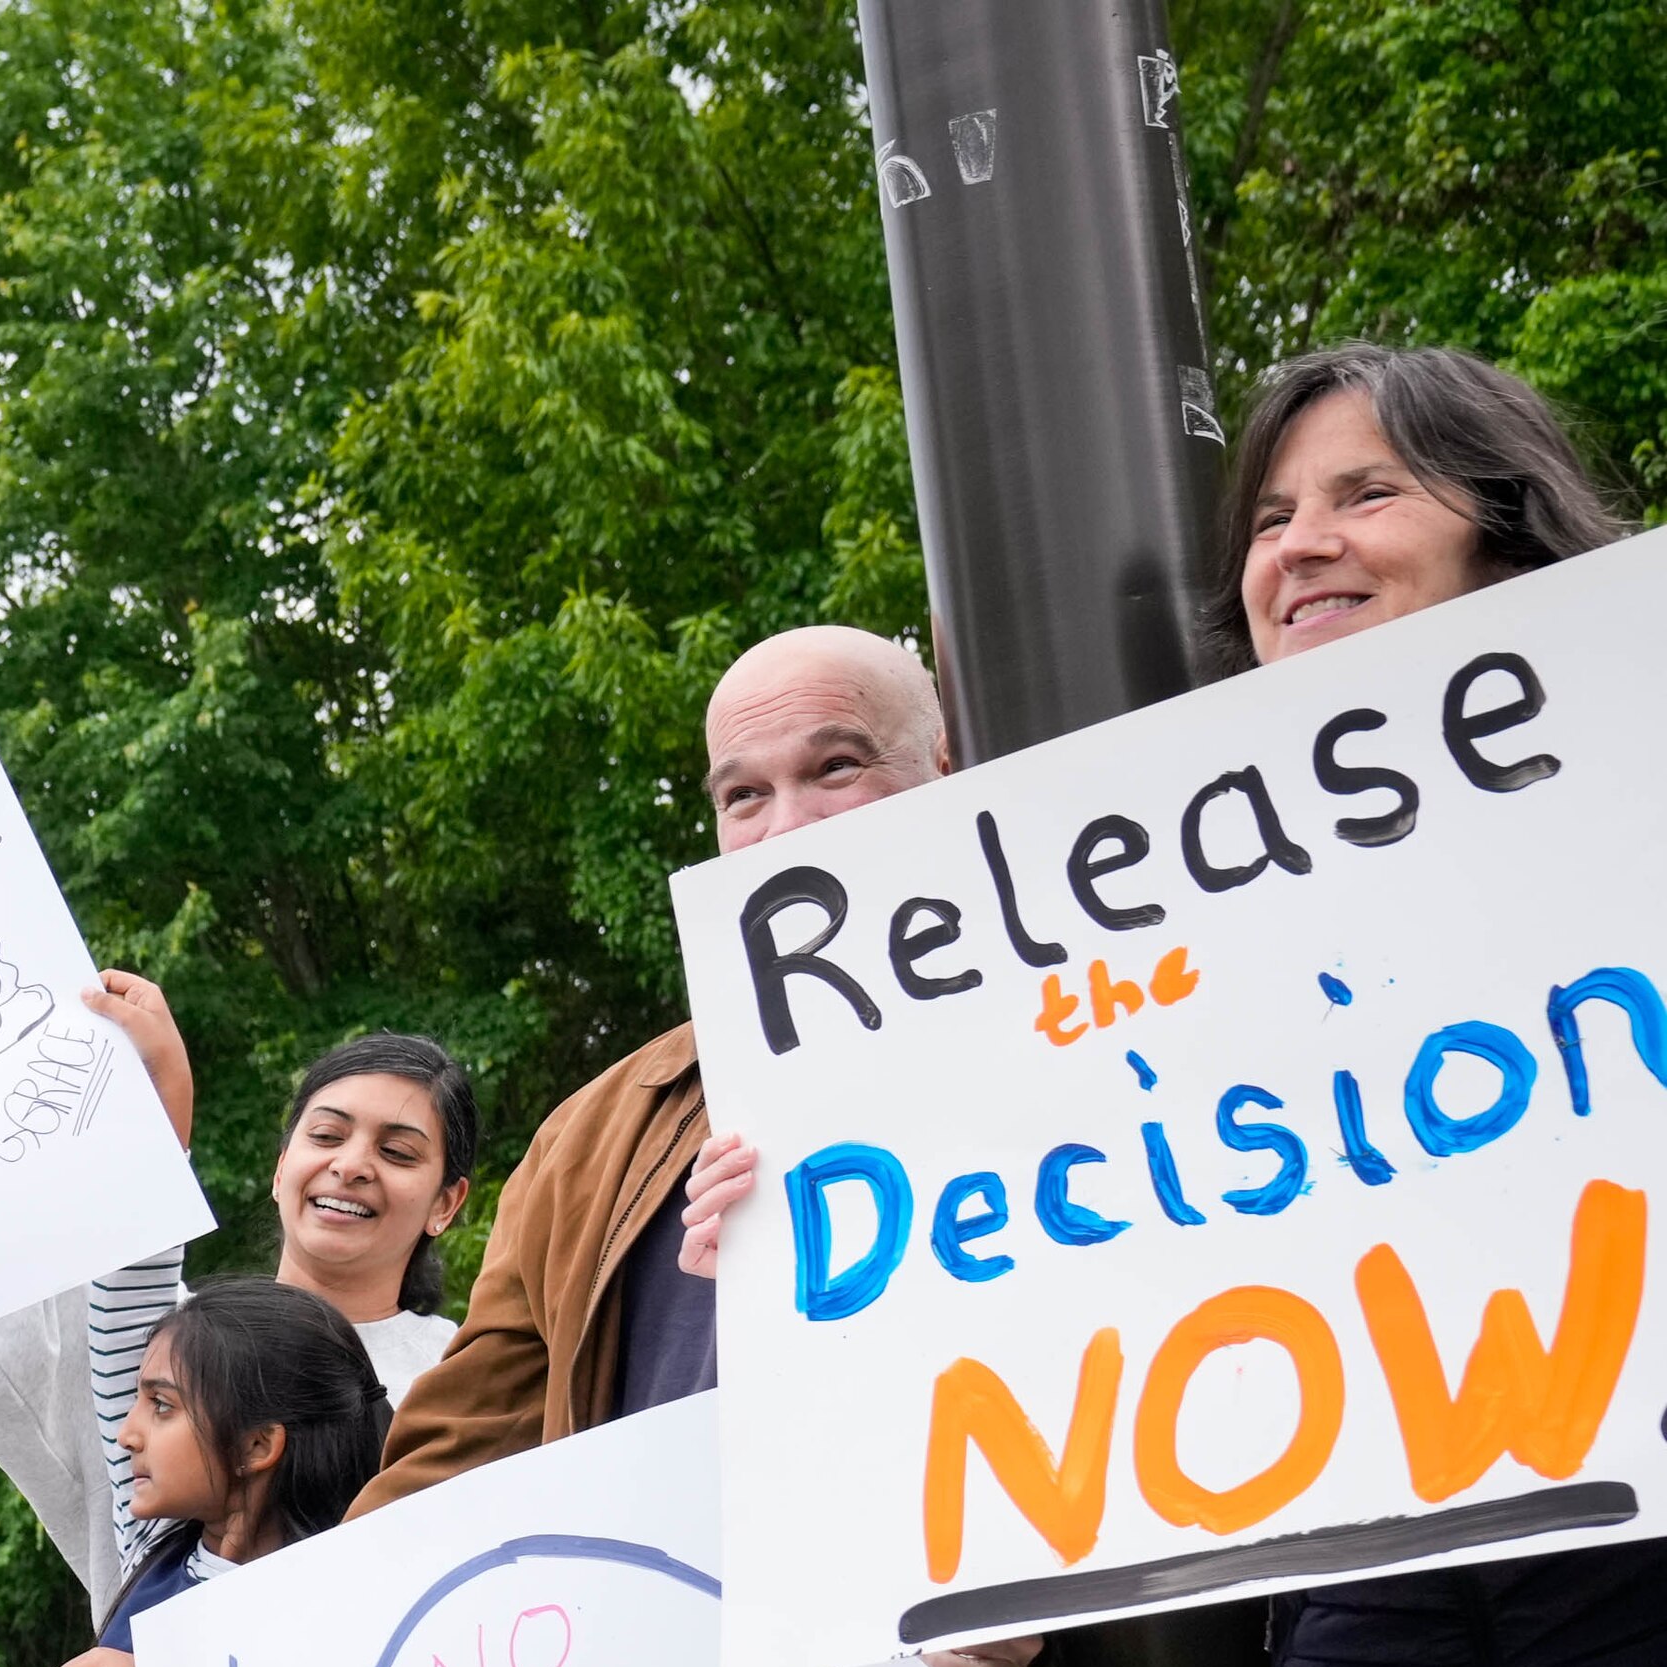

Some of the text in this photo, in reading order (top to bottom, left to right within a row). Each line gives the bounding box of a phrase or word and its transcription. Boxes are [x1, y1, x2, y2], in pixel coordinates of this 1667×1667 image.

[739, 650, 1563, 1055] Release
[1035, 945, 1200, 1047] the
[784, 965, 1667, 1321] Decision
